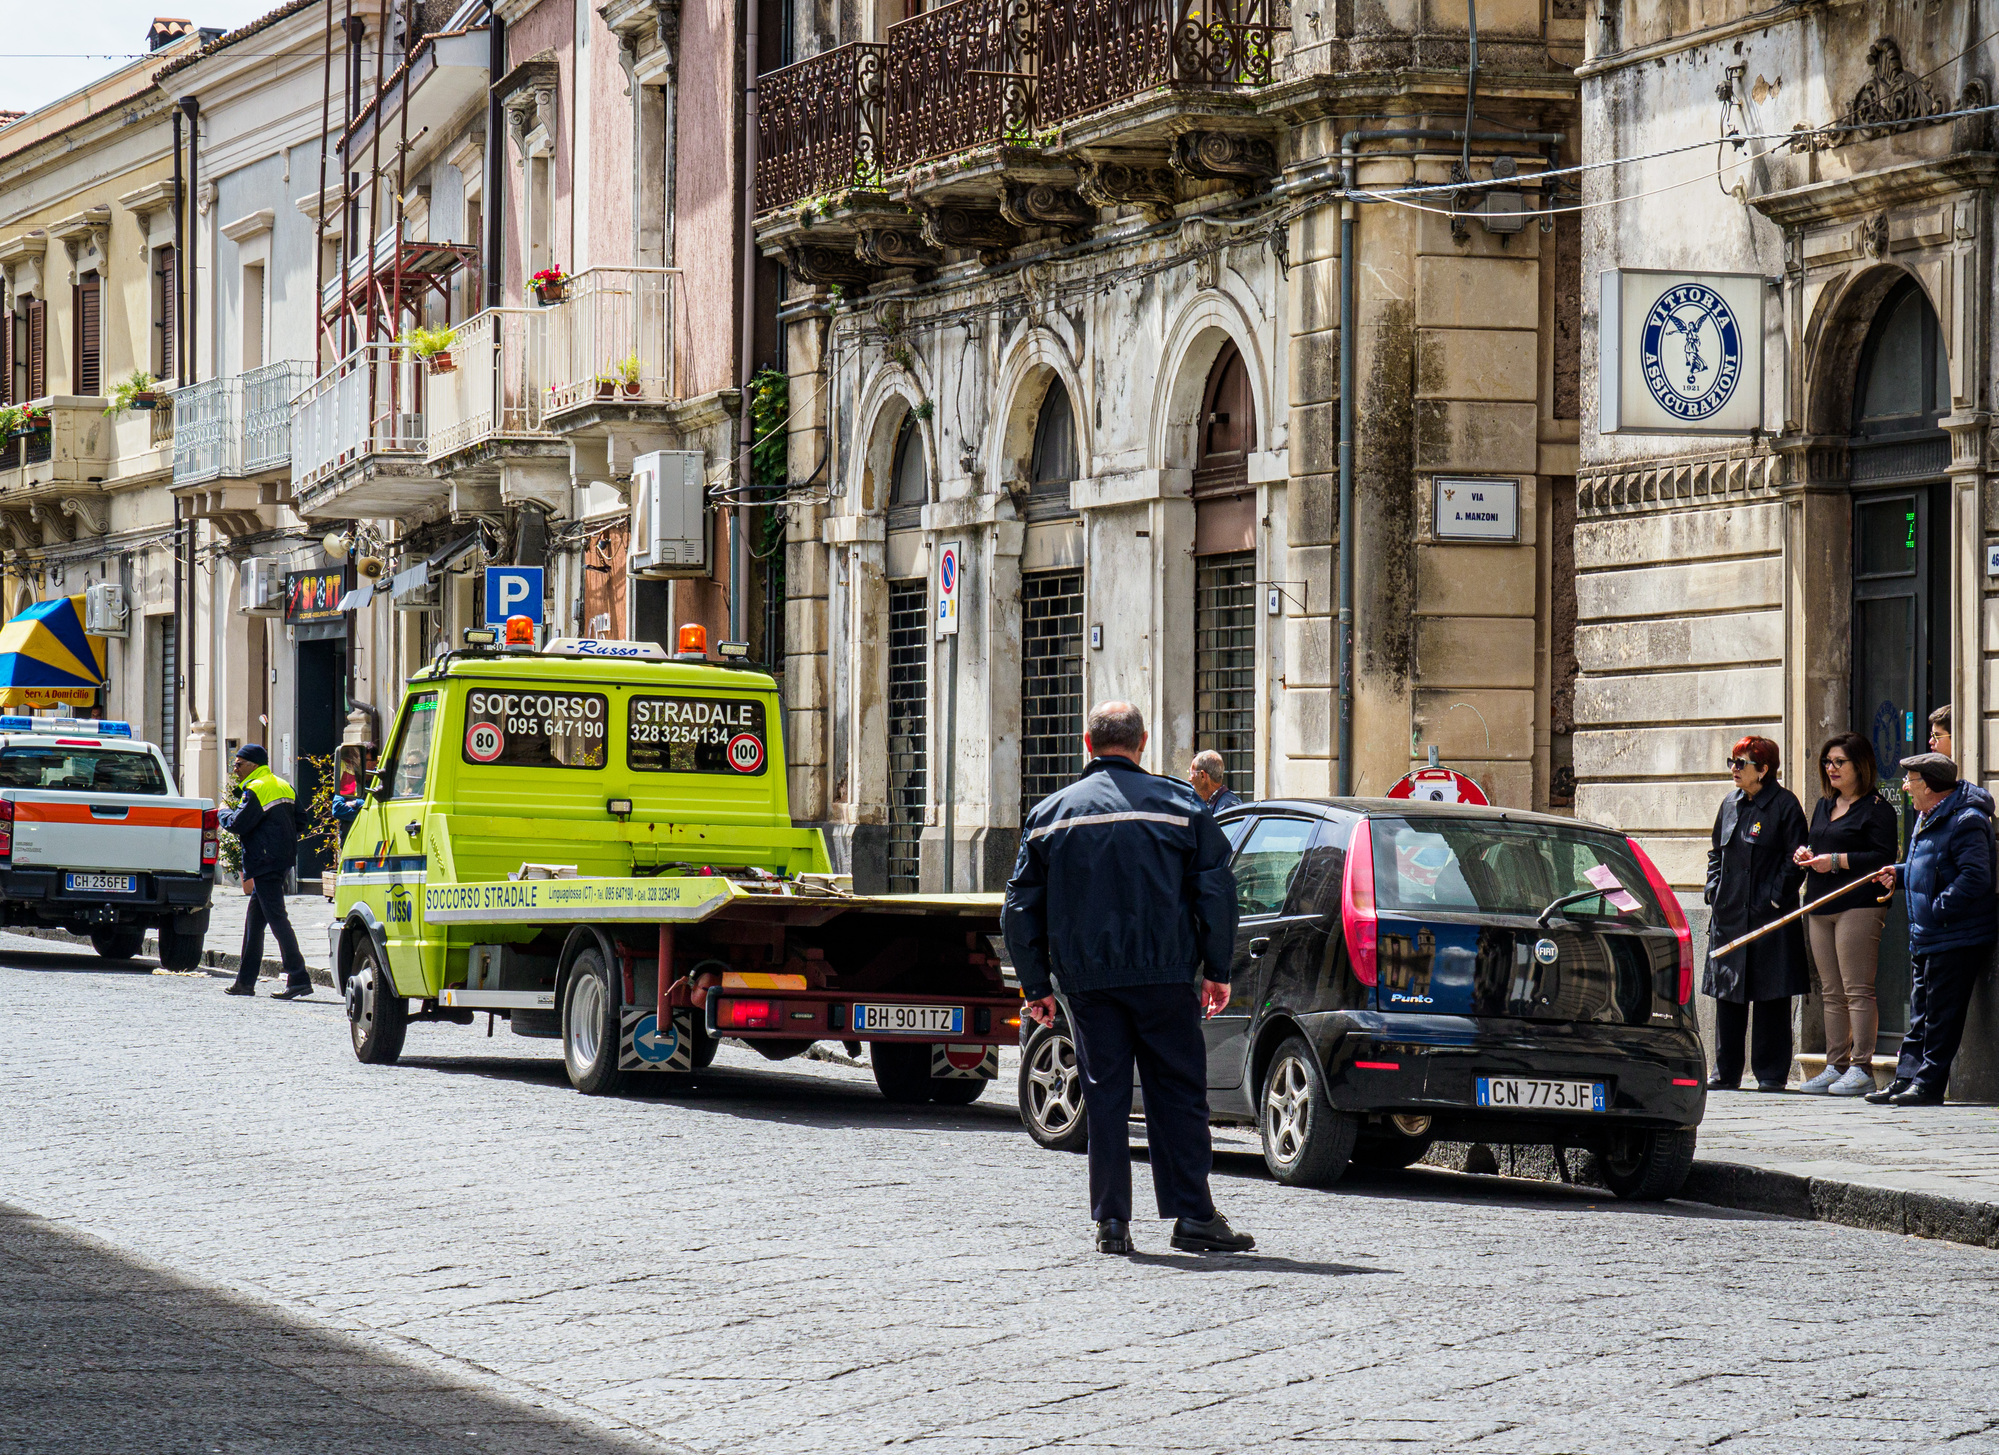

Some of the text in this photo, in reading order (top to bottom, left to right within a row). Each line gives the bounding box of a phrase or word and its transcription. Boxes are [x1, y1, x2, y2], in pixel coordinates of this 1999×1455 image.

[1650, 288, 1731, 329] VITTORIA
[1645, 352, 1737, 416] ASSICURAZIONI
[1471, 493, 1484, 502] VIA
[1455, 512, 1499, 522] A. MANZONI
[499, 575, 530, 616] P
[577, 640, 638, 656] Russo
[24, 689, 89, 700] Serv. A Domicilio
[472, 693, 601, 719] SOCCORSO
[636, 701, 753, 726] STRADALE
[508, 716, 604, 739] 095 647190
[476, 732, 494, 749] 80
[734, 744, 757, 760] 100
[426, 885, 537, 910] SOCCORSO STRADALE
[583, 886, 593, 903] (CT)
[605, 886, 615, 900] 095
[616, 886, 633, 900] 647190
[648, 887, 657, 901] 328
[658, 887, 680, 901] 3254134
[386, 900, 412, 922] RUSSO
[1539, 947, 1555, 956] FIAT
[1391, 993, 1434, 1004] Punto
